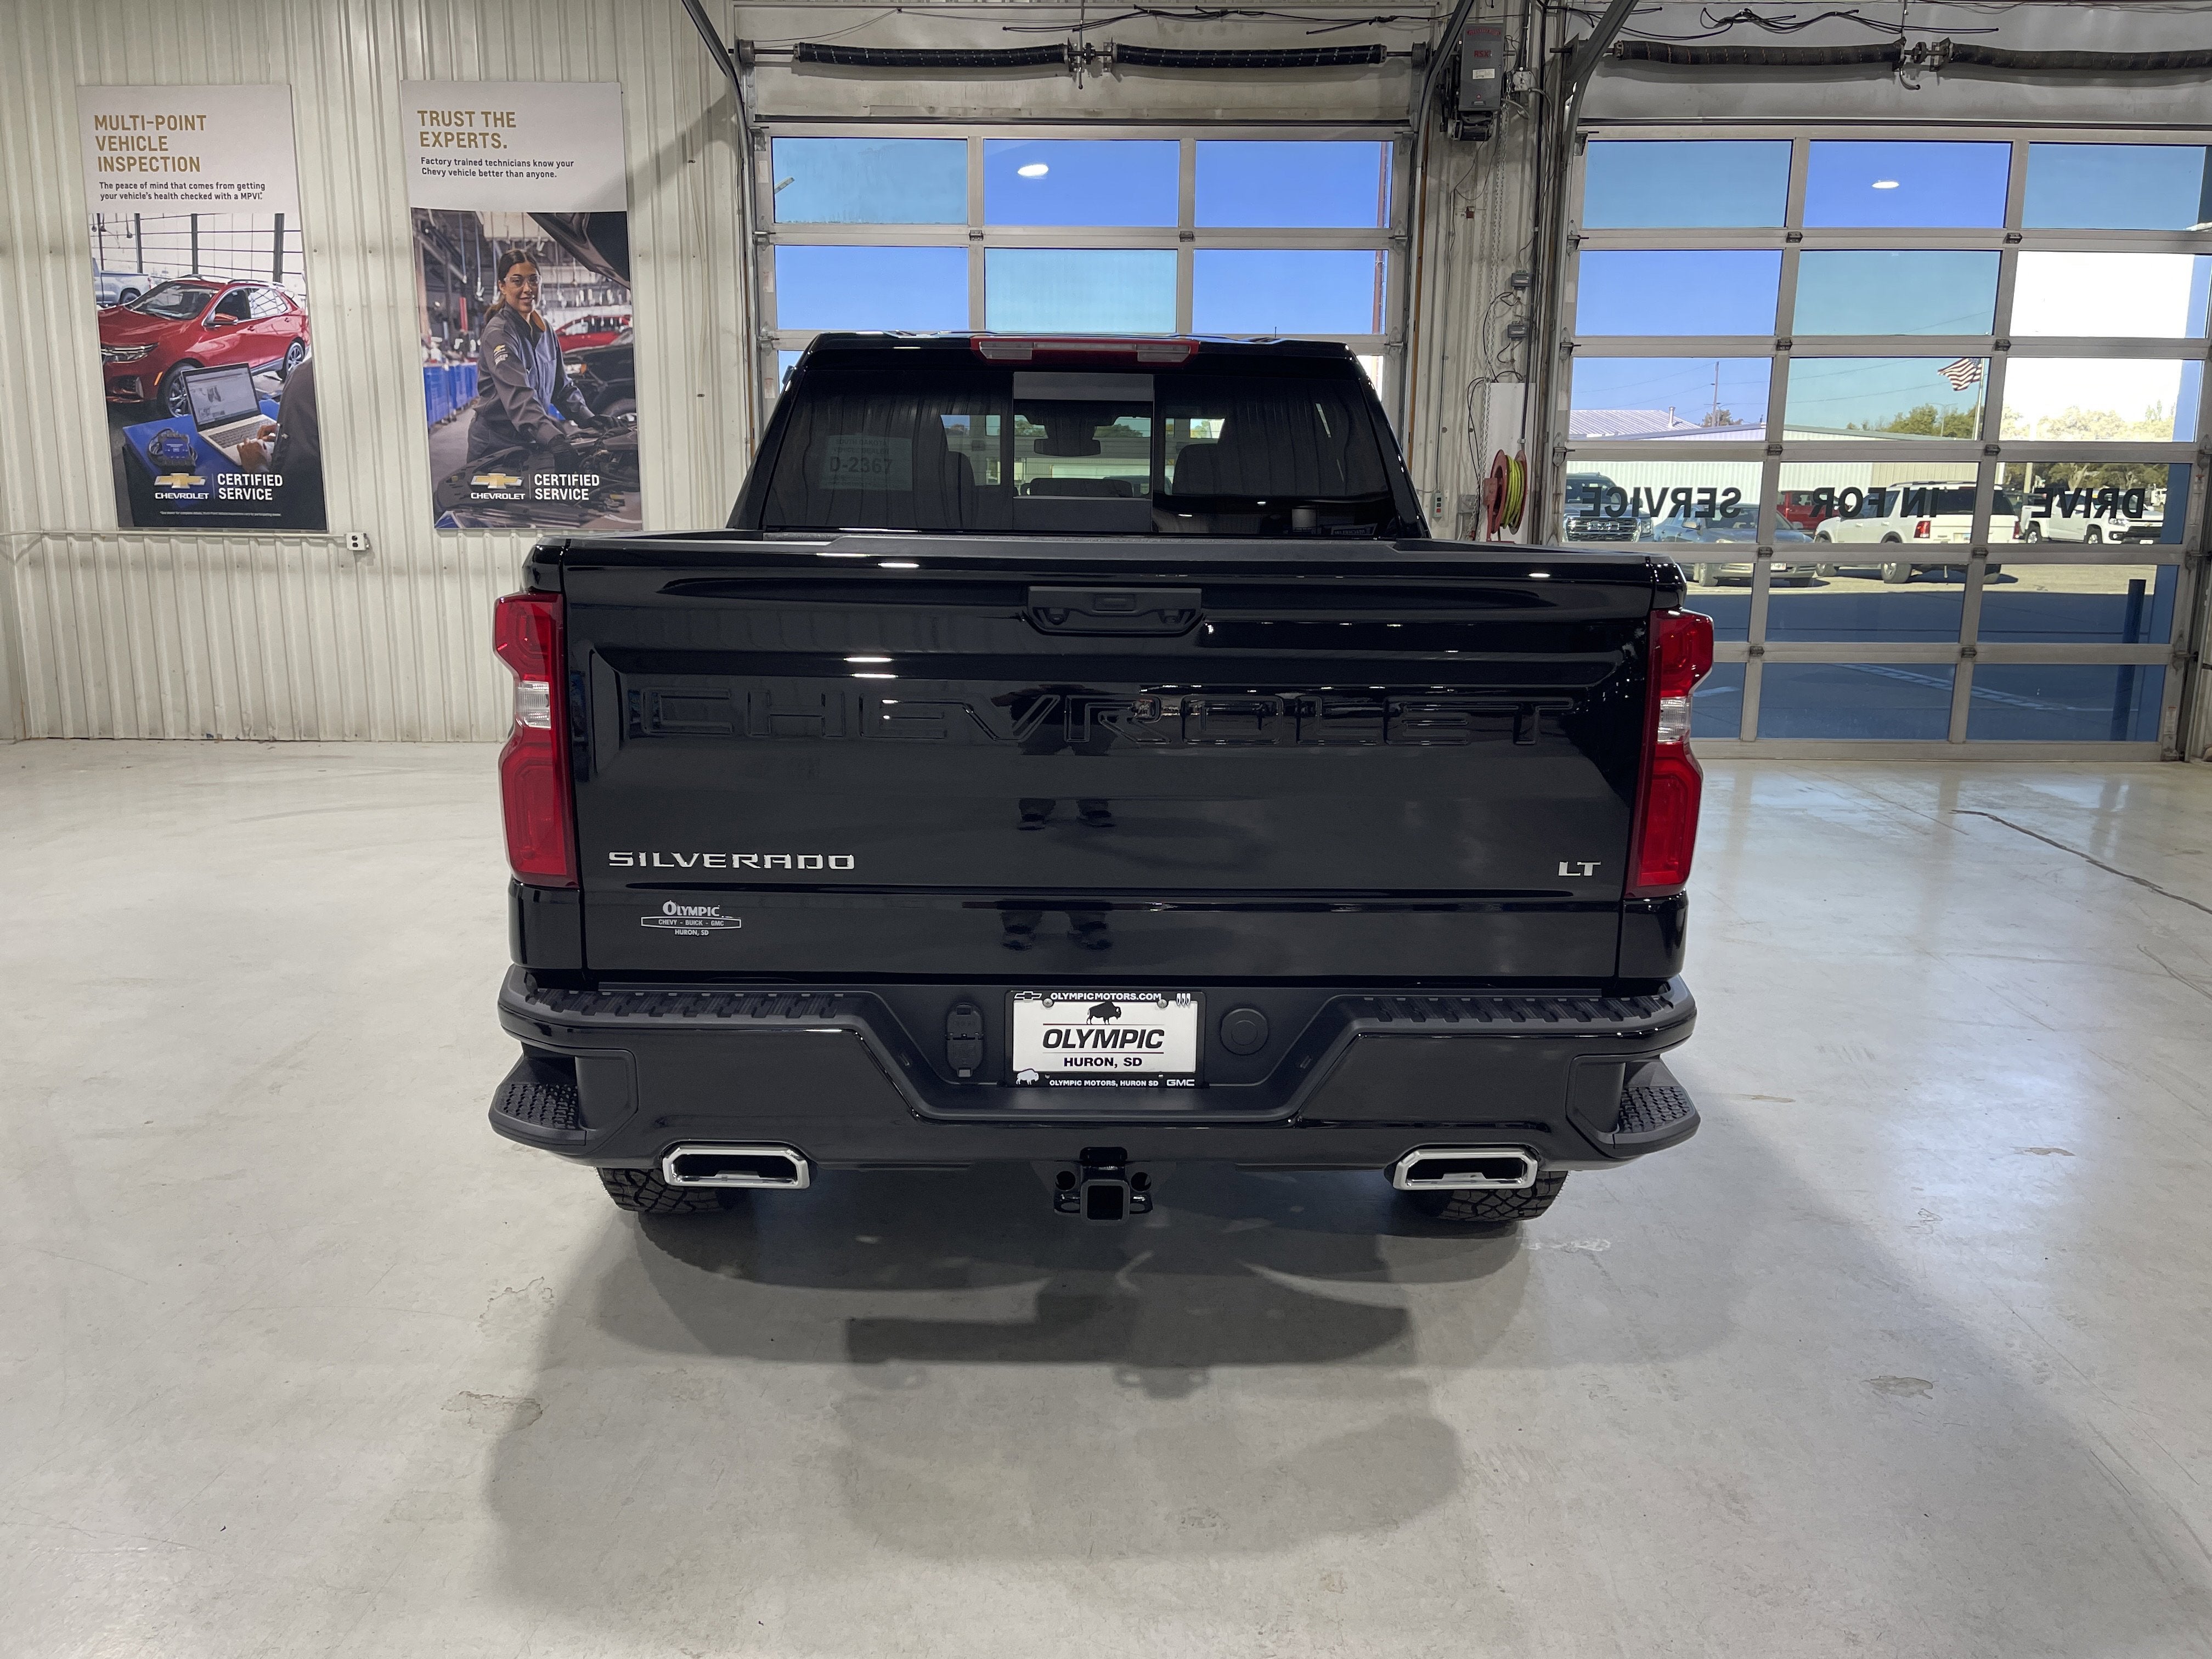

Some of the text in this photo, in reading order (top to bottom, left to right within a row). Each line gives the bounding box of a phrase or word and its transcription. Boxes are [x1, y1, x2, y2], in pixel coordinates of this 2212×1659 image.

[94, 115, 207, 131] MULTI-POINT
[417, 110, 516, 128] TRUST THE
[95, 136, 168, 151] VEHICLE
[420, 131, 507, 149] EXPERTS.
[98, 156, 201, 172] INSPECTION
[421, 157, 452, 166] Factory
[454, 158, 482, 166] trained
[422, 168, 445, 177] Chevy
[237, 182, 266, 191] getting
[830, 456, 893, 474] D-2367
[217, 473, 283, 487] CERTIFIED
[534, 474, 600, 487] CERTIFIED
[155, 492, 210, 500] CHEVROLET
[219, 488, 273, 500] SERVICE
[535, 488, 589, 500] SERVICE
[642, 686, 1573, 745] CHEVROLET
[608, 851, 855, 870] SILVERADO
[1558, 861, 1601, 876] LT
[1050, 992, 1161, 1001] OLYMPICMOTORS.COM
[1042, 1029, 1165, 1049] OLYMPIC
[1064, 1057, 1143, 1069] HURON, SD
